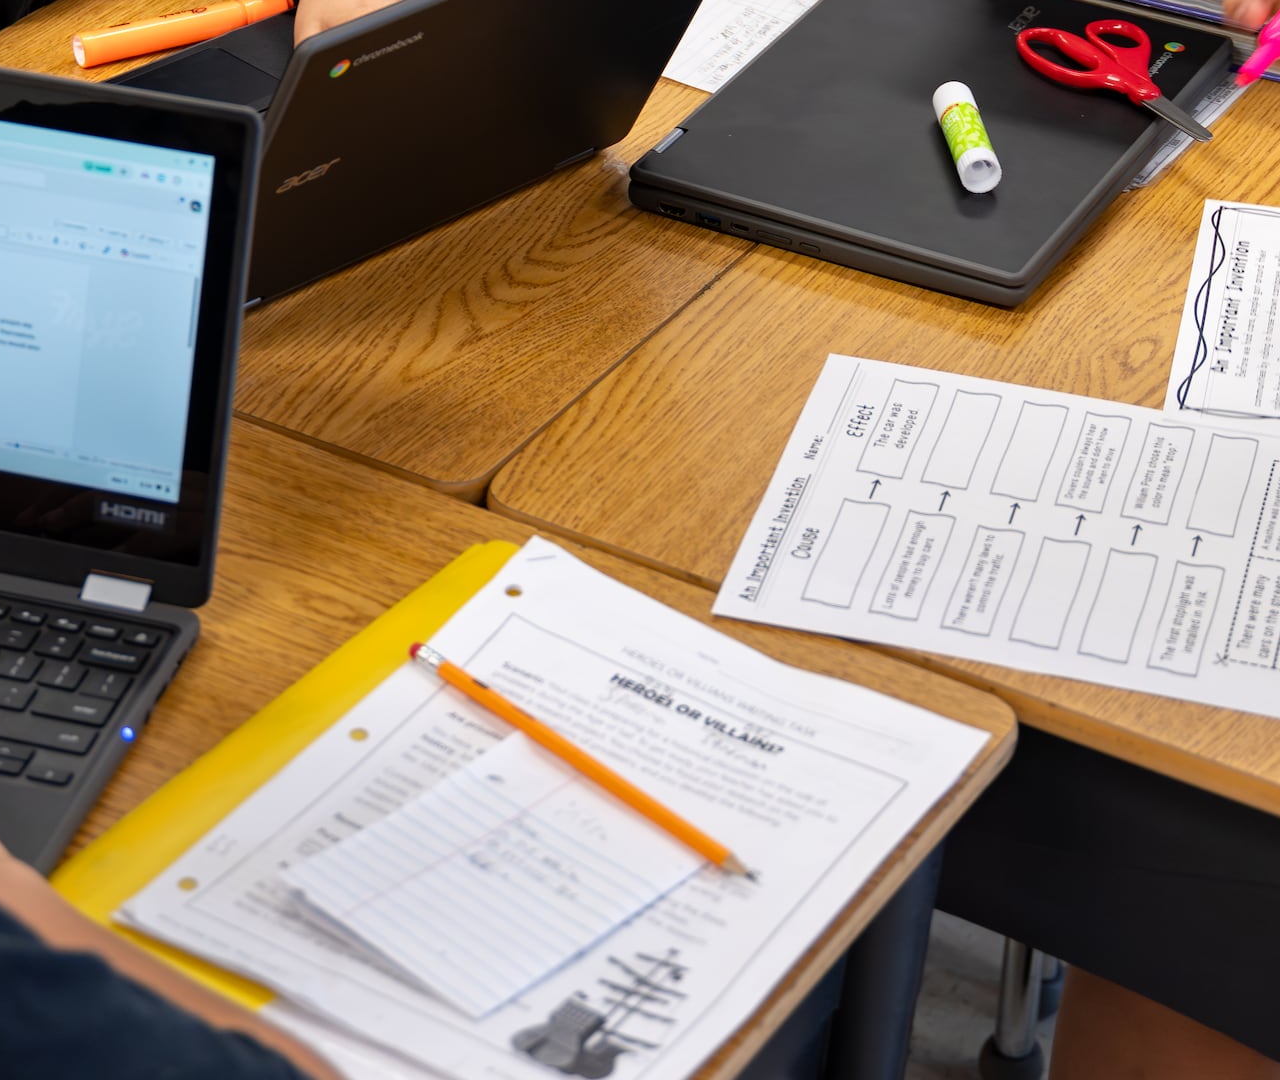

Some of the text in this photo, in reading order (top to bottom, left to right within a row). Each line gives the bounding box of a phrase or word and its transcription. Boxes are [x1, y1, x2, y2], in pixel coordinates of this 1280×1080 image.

[275, 156, 342, 195] acer
[1209, 241, 1249, 375] An Important Invention
[846, 405, 874, 437] Effect
[872, 403, 903, 447] The car was
[804, 435, 823, 460] Name:
[99, 500, 166, 528] HDMI
[738, 477, 806, 601] An Important Invention
[790, 527, 819, 559] Cause
[1236, 574, 1270, 648] There were many
[1258, 639, 1272, 659] cars
[675, 703, 703, 720] OR
